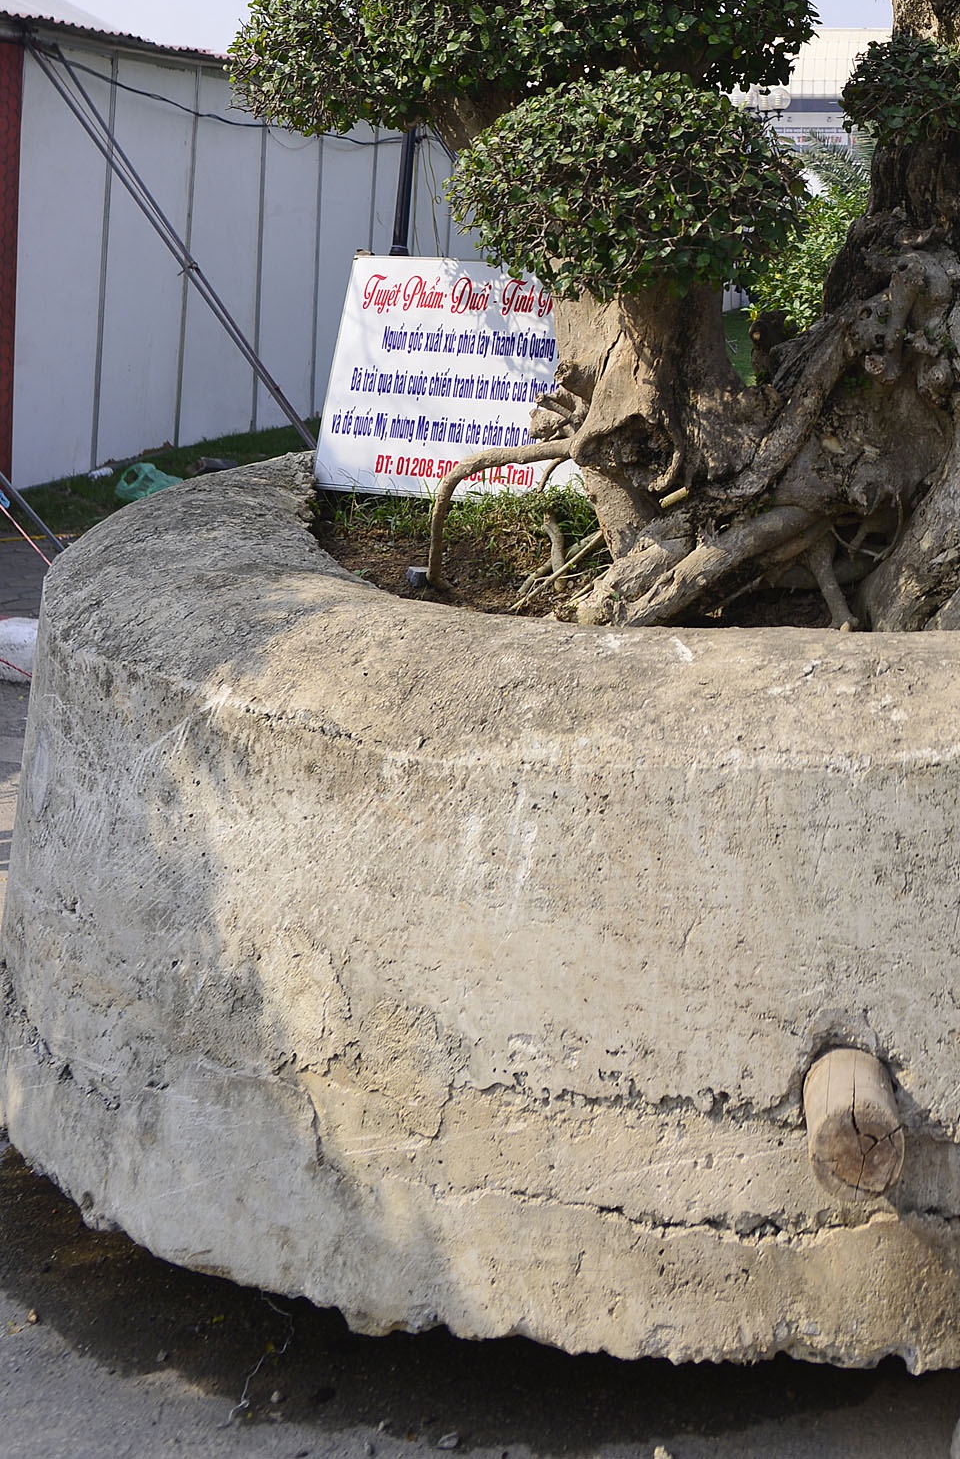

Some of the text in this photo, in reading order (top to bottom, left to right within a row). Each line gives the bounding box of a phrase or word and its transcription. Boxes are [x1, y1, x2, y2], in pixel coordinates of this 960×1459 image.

[362, 274, 402, 314] Tuyệt
[402, 276, 447, 312] Phẩm:
[501, 279, 535, 316] Tình
[407, 323, 424, 354] gốc
[423, 323, 444, 353] xuất
[456, 329, 476, 356] phía
[476, 330, 490, 358] tây
[491, 330, 516, 356] Thành
[529, 330, 556, 361] Quảng
[350, 367, 363, 391] Đã
[362, 365, 379, 393] trải
[377, 373, 393, 396] qua
[392, 369, 409, 394] hai
[407, 370, 428, 401] cuộc
[428, 367, 453, 398] chiến
[452, 374, 475, 399] tranh
[489, 372, 511, 401] khốc
[511, 373, 528, 402] của
[331, 408, 342, 434] và
[341, 406, 357, 435] đế
[353, 407, 374, 438] quốc
[415, 415, 430, 447] Mẹ
[429, 417, 448, 443] mãi
[447, 418, 466, 444] mãi
[465, 419, 481, 445] che
[503, 422, 521, 447] cho
[375, 454, 393, 475] ĐT:
